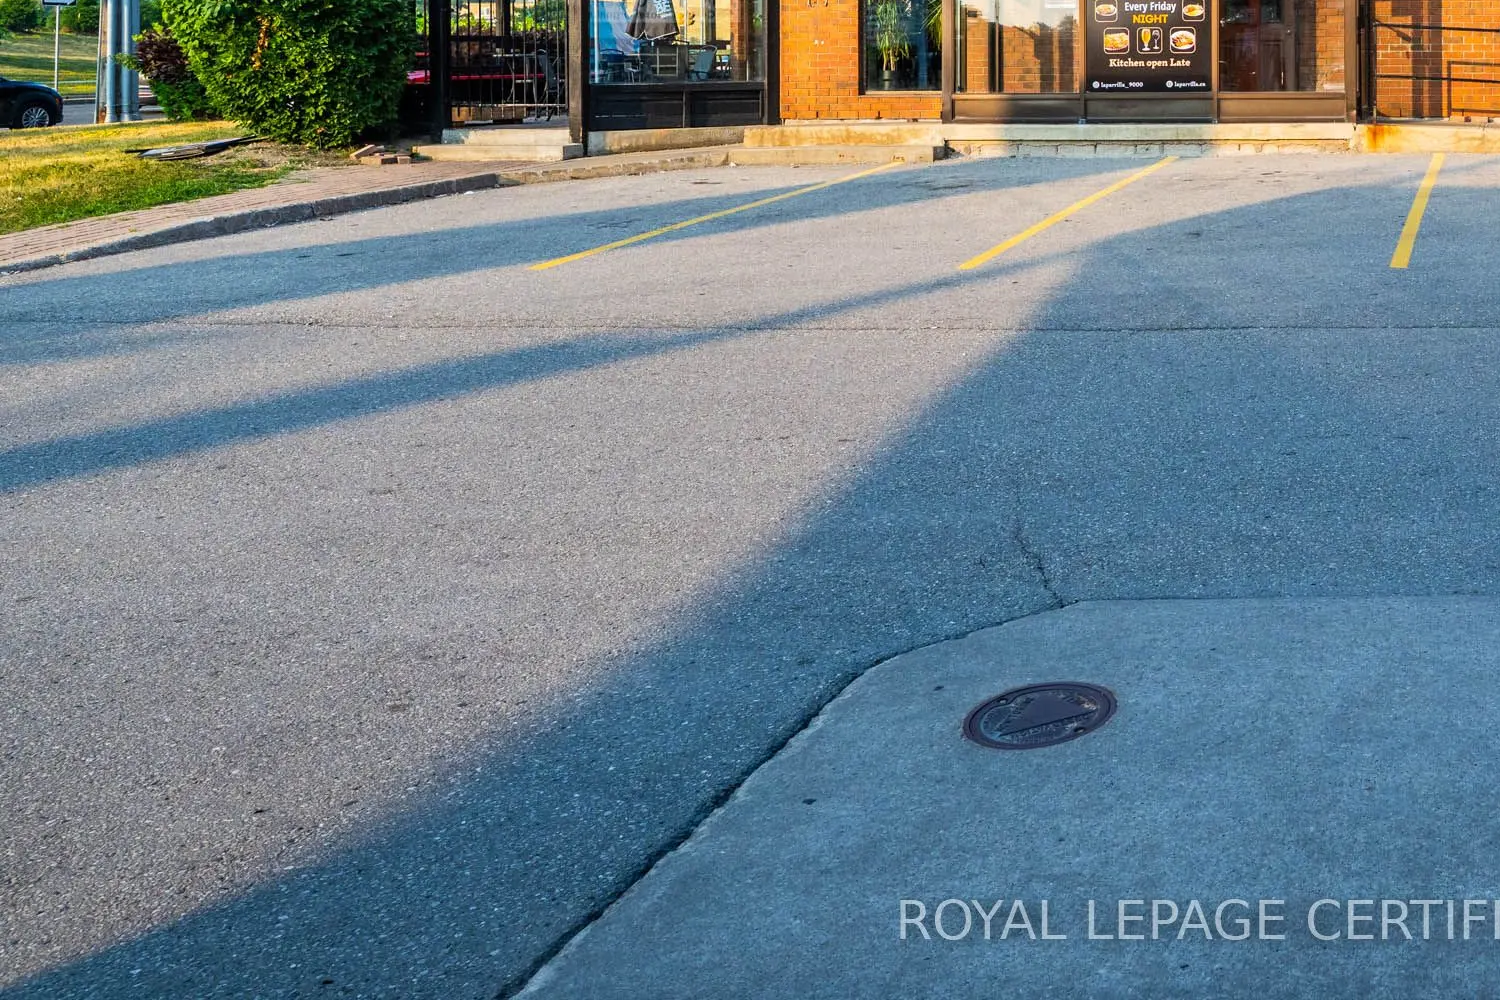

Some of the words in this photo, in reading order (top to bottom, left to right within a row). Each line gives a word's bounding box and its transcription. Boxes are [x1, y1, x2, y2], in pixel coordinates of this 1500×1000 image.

[1124, 1, 1148, 13] Every
[1150, 1, 1177, 13] Friday
[1132, 14, 1169, 24] NIGHT
[1109, 58, 1145, 67] Kitchen
[1146, 60, 1168, 69] open
[1170, 58, 1191, 67] Late
